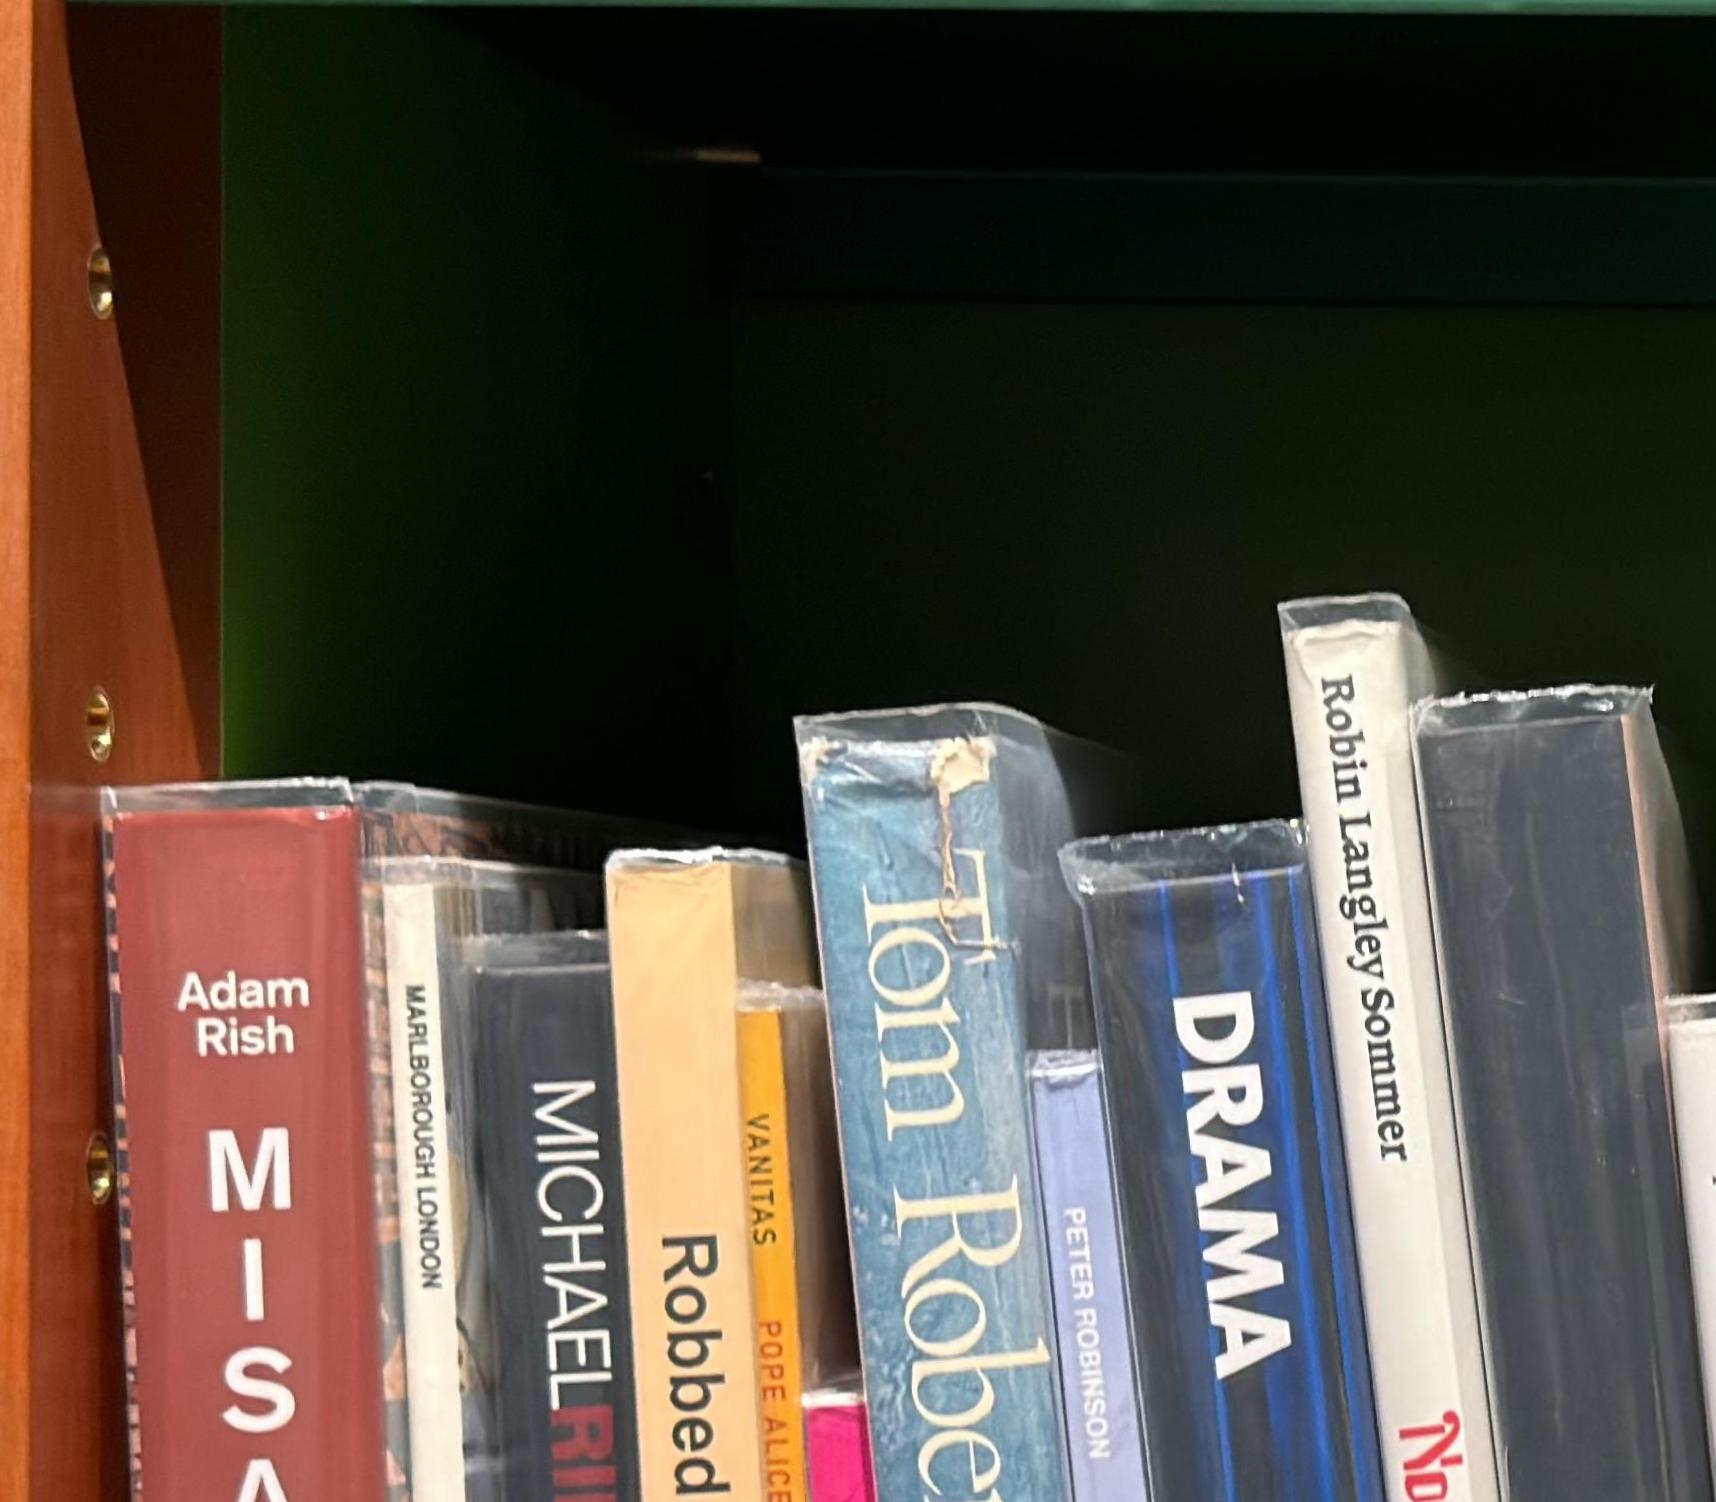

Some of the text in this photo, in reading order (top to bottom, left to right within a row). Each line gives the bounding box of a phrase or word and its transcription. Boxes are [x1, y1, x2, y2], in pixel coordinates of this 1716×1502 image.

[178, 972, 310, 1012] Adam
[197, 1017, 294, 1056] Rish
[863, 847, 997, 1143] Tom
[1320, 672, 1408, 1164] Robin Langley Sommer
[405, 985, 444, 1290] MARLBOROUGH LONDON
[747, 1112, 777, 1246] VANITAS
[1171, 990, 1293, 1380] DRAMA
[660, 1235, 730, 1494] Robbed
[758, 1321, 786, 1402] POPE
[1062, 1207, 1111, 1460] PETER ROBINSON
